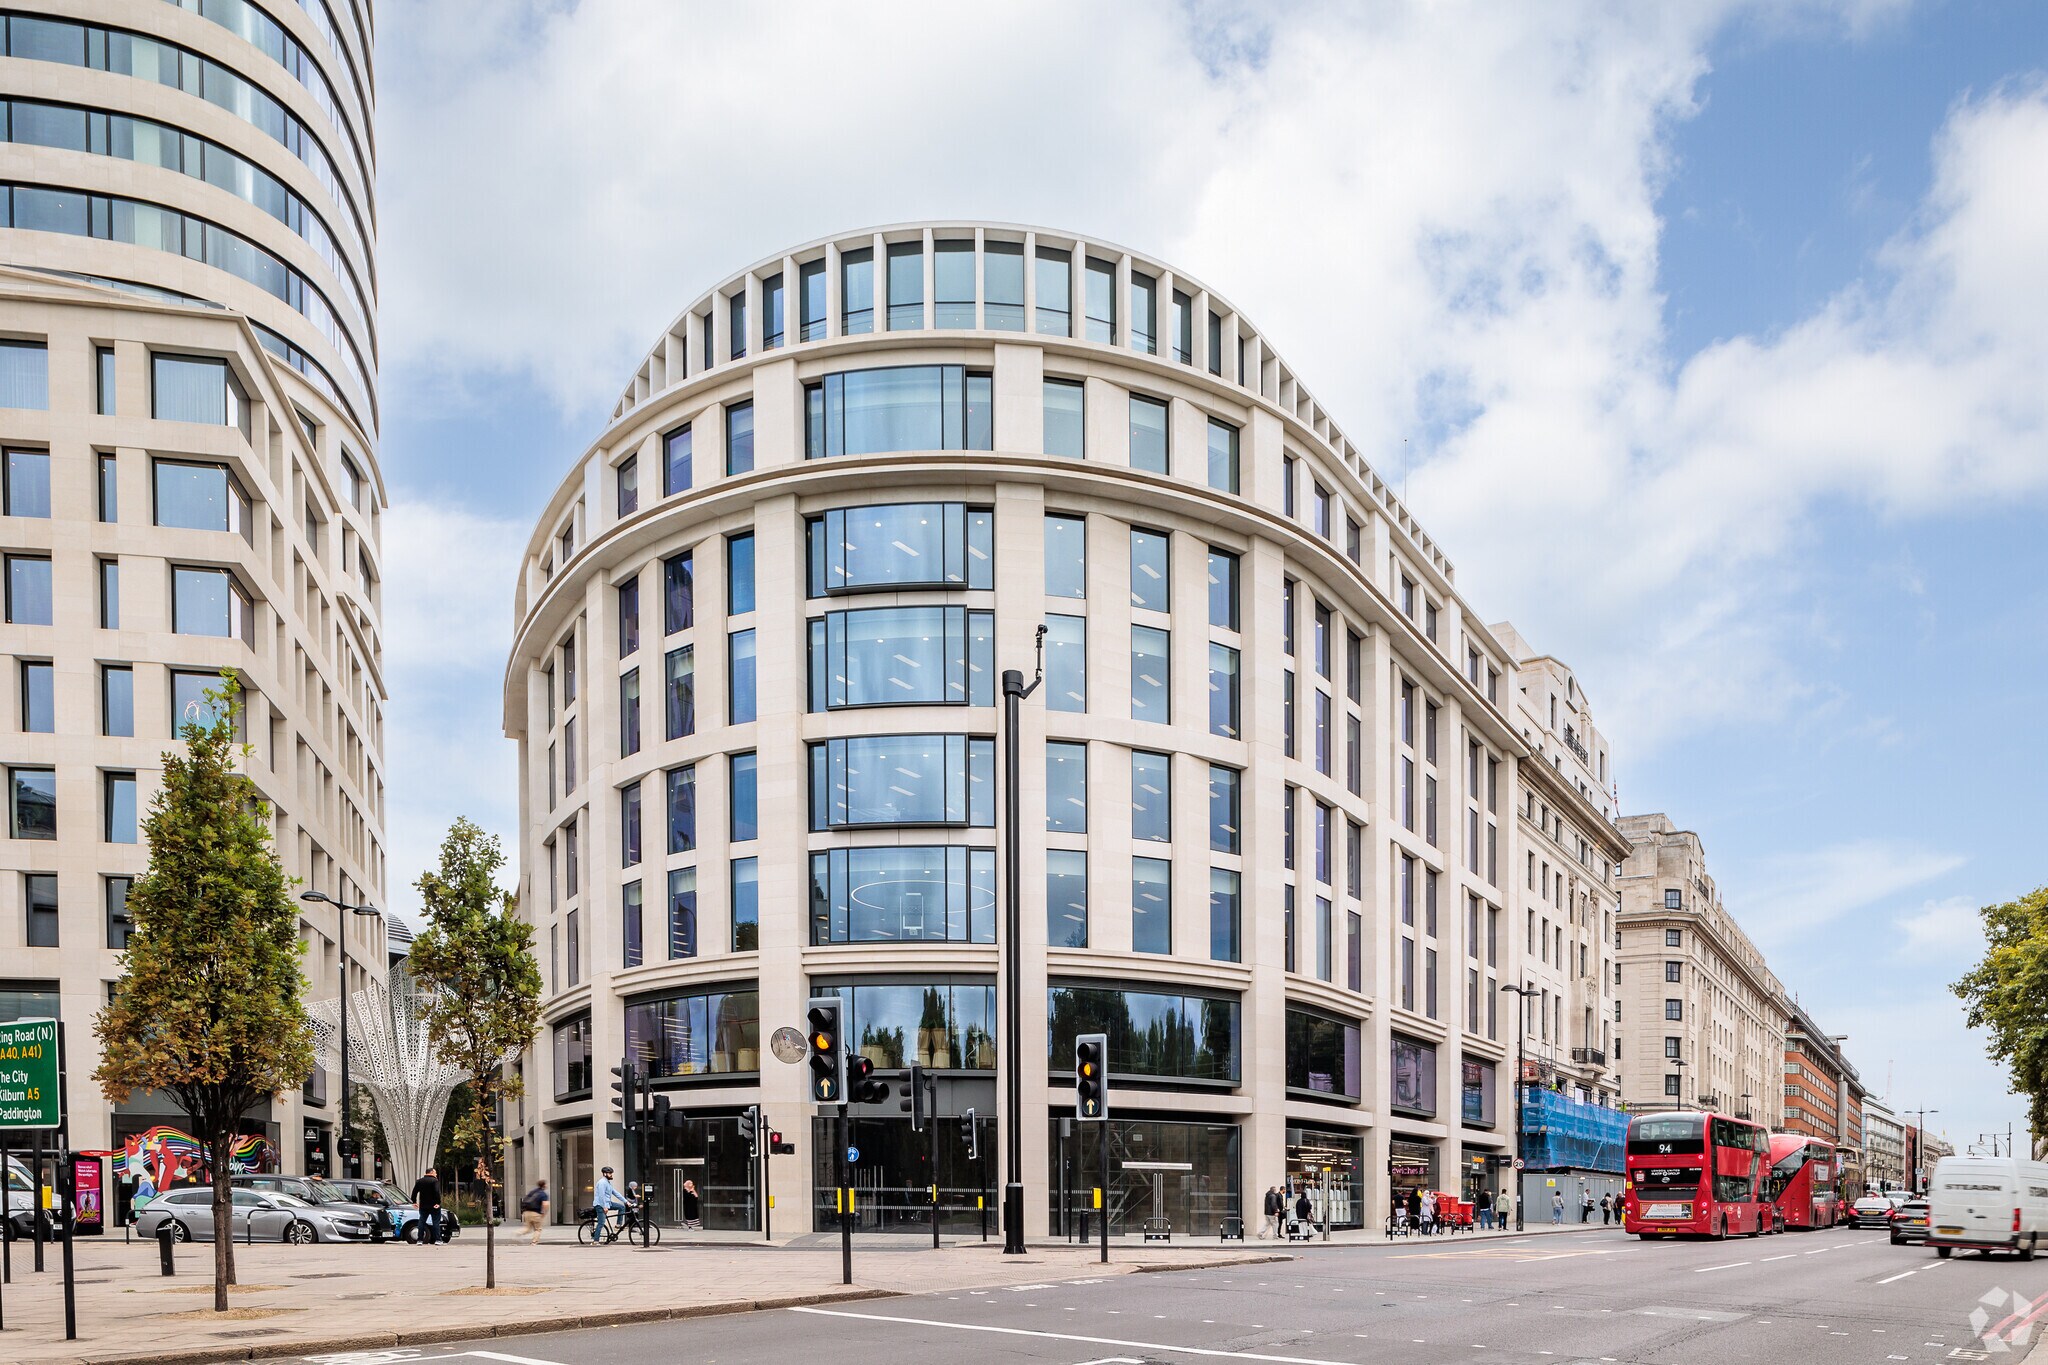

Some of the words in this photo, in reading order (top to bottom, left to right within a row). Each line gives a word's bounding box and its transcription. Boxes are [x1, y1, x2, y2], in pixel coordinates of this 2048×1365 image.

[0, 1031, 13, 1045] ing
[15, 1028, 35, 1042] Road
[37, 1025, 53, 1042] (N)
[22, 1044, 42, 1059] A41)
[12, 1070, 28, 1085] City
[1659, 1143, 1672, 1153] 94
